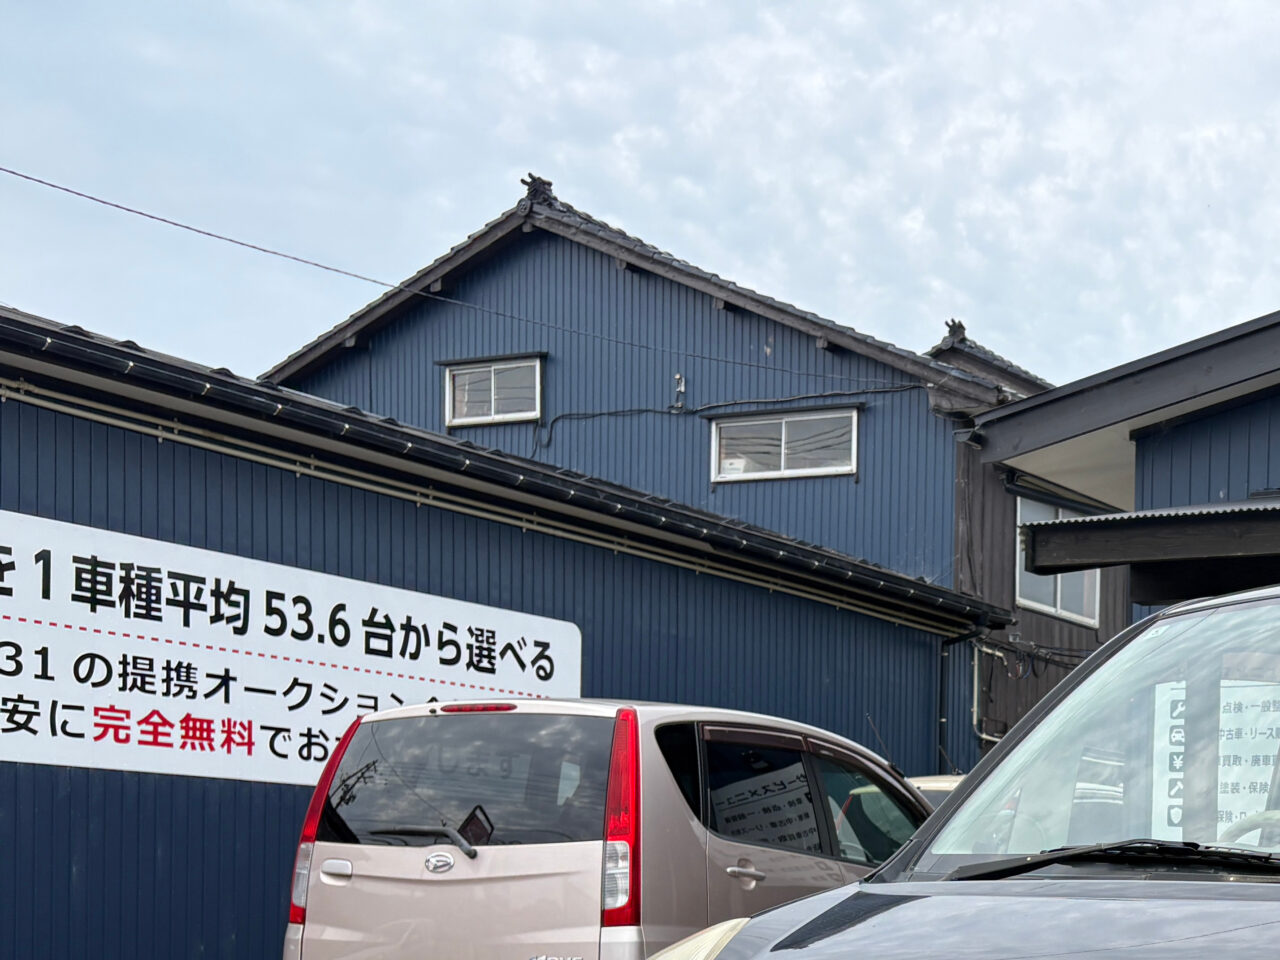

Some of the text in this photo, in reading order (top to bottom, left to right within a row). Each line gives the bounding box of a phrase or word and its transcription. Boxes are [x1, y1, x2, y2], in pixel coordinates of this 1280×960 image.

[0, 640, 440, 716] 31の提携オークショ
[1, 695, 341, 762] 安に完全無料でお
